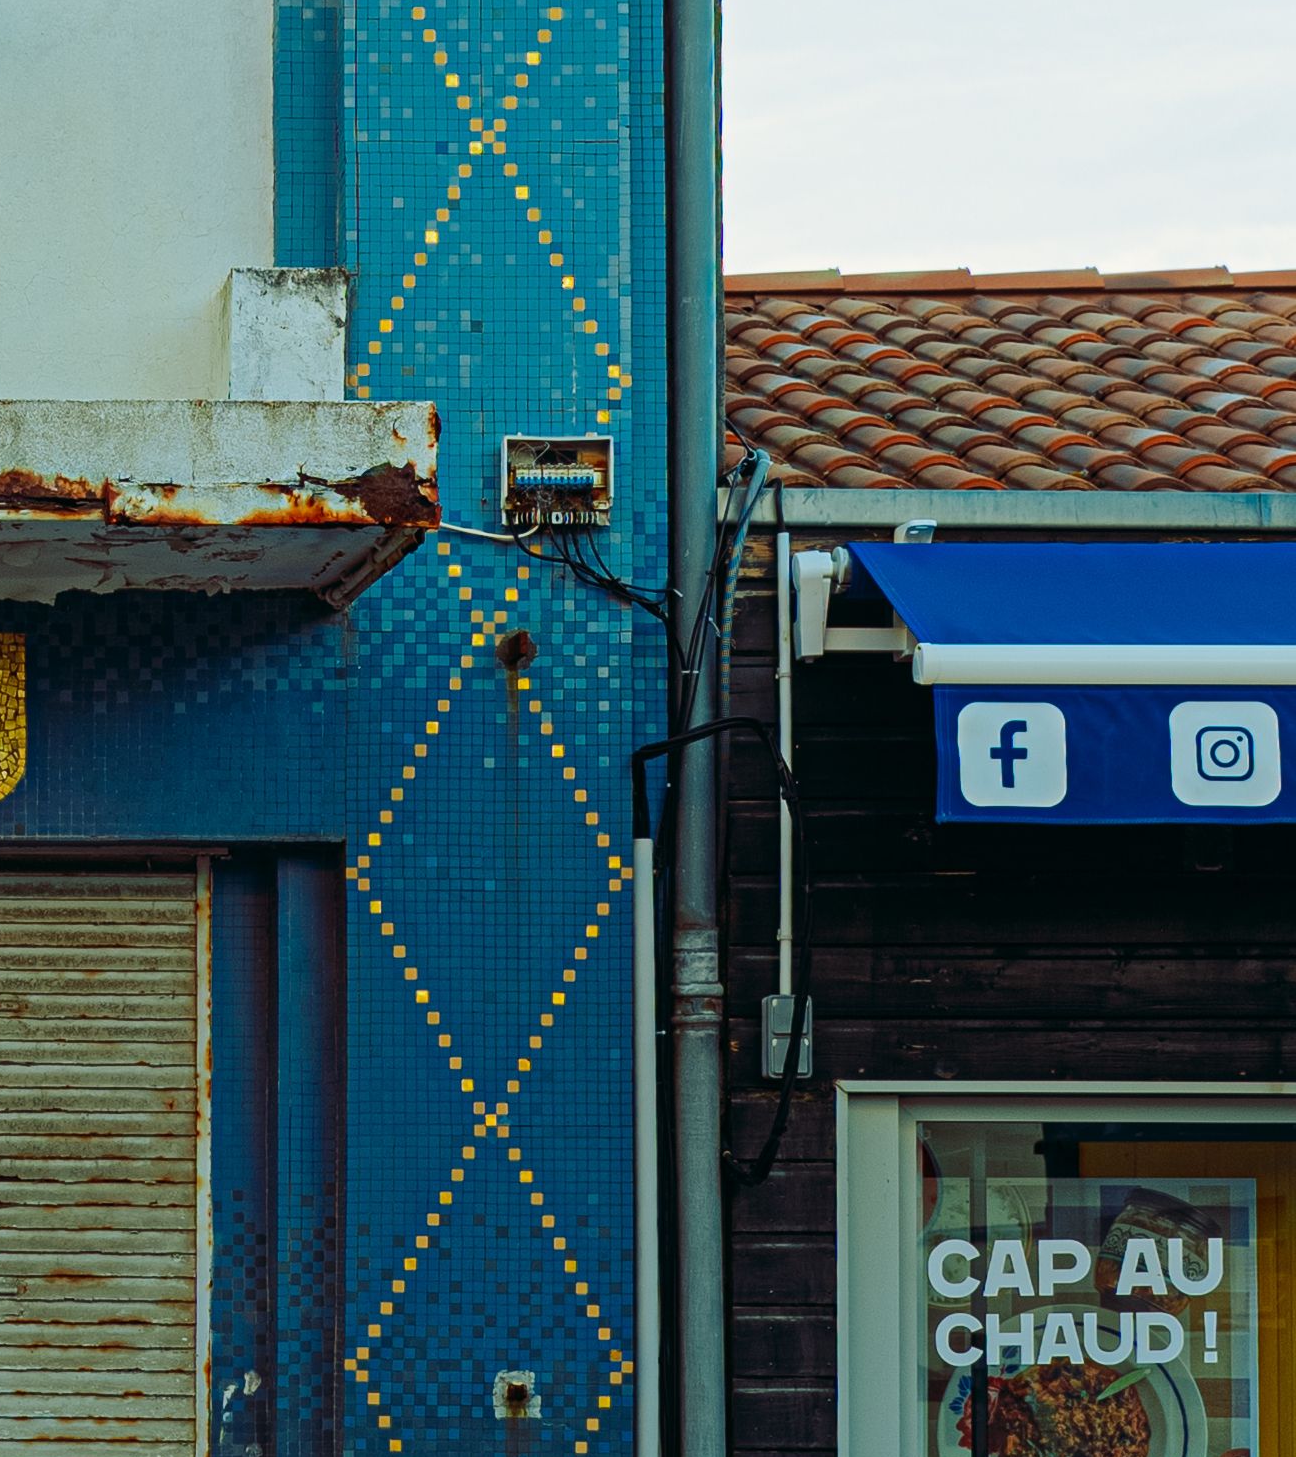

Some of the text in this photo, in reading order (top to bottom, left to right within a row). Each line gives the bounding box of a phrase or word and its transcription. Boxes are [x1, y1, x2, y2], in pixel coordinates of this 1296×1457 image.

[927, 1236, 1224, 1299] CAP AU
[935, 1311, 1185, 1368] CHAUD
